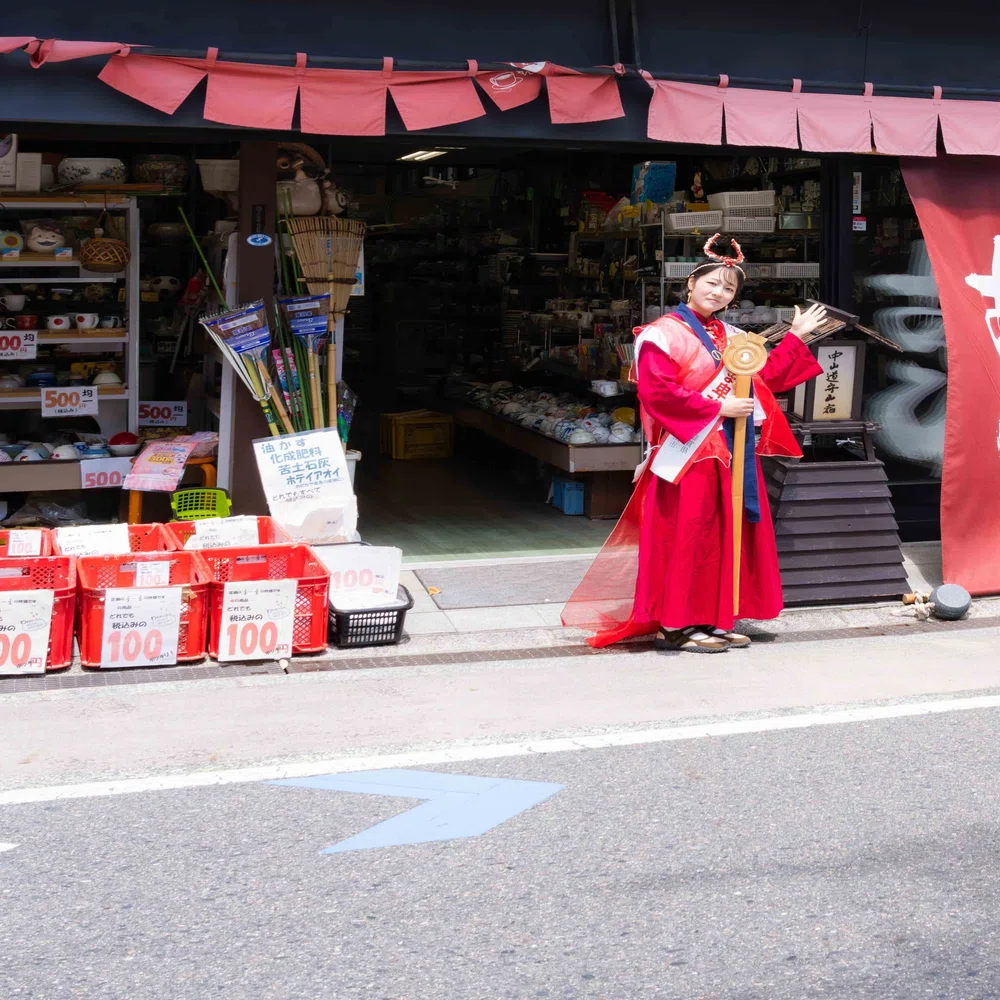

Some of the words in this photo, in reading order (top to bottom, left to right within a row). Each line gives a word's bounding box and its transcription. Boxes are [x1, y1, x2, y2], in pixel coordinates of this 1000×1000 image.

[822, 350, 843, 415] 中山道守山宿
[261, 438, 307, 454] 油かす
[270, 446, 322, 464] 化成肥料
[278, 457, 332, 476] 苦土石灰
[286, 467, 341, 486] ホテイアオイ
[333, 568, 373, 589] 100
[112, 621, 147, 630] 税込みの
[229, 613, 263, 622] 税込みの
[108, 629, 163, 663] 100
[227, 621, 279, 656] 100
